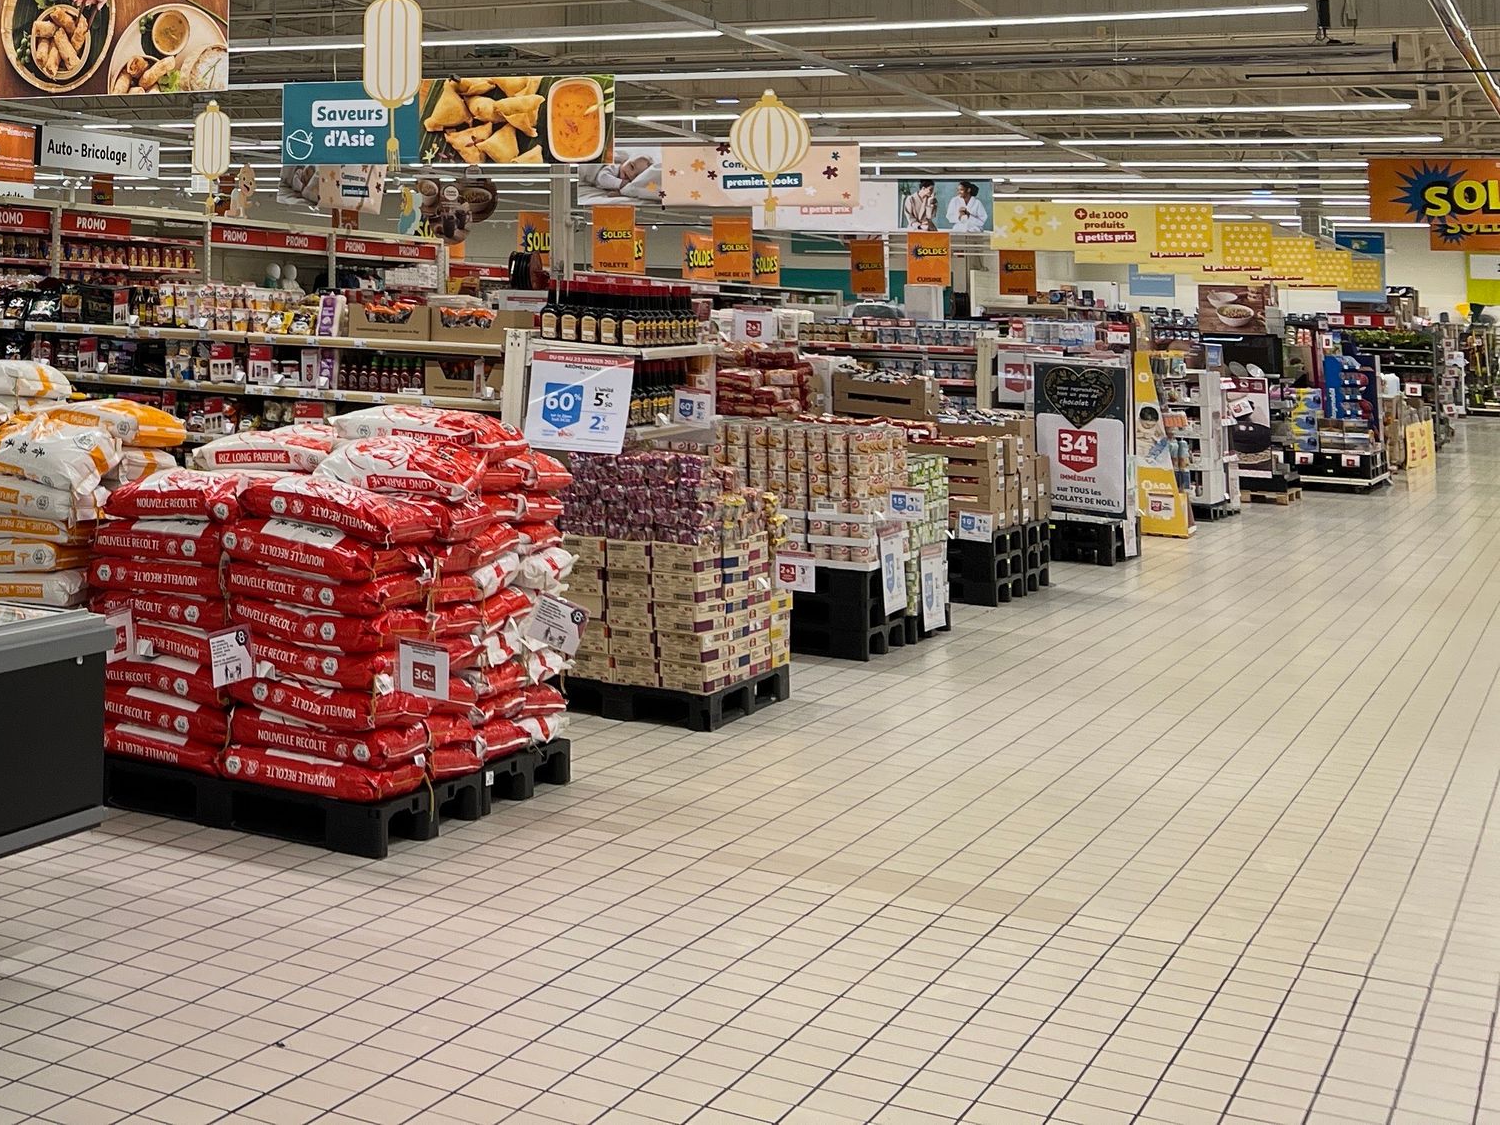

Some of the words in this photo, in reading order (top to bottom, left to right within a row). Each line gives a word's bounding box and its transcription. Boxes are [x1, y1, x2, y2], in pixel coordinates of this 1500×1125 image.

[316, 105, 384, 123] Saveurs
[323, 129, 375, 148] d'Asie
[47, 138, 73, 158] Auto
[80, 142, 128, 164] Bricolage
[1089, 210, 1101, 219] de
[1102, 210, 1129, 220] 1000
[76, 216, 107, 231] PROMO
[1083, 220, 1126, 230] produits
[222, 229, 248, 243] PROMO
[285, 235, 309, 248] PROMO
[601, 230, 633, 240] SOLDES
[1084, 232, 1114, 243] petits
[1114, 232, 1136, 243] prix
[344, 241, 366, 254] PROMO
[398, 245, 420, 257] PROMO
[721, 243, 750, 252] SOLDES
[917, 247, 948, 256] SOLDES
[1059, 398, 1090, 407] chocolat
[1059, 433, 1097, 455] 34%
[218, 452, 231, 463] RIZ
[232, 452, 253, 463] LONG
[1060, 472, 1096, 483] IMMÉDIATE
[1069, 486, 1090, 495] TOUS
[1090, 488, 1102, 496] les
[169, 497, 198, 509] RECOLTE
[1050, 493, 1084, 505] OCOLATS
[1084, 497, 1094, 505] DE
[1095, 497, 1116, 508] NOËL
[97, 535, 131, 547] NOUVELLE
[131, 538, 160, 551] RECOLTE
[230, 573, 266, 591] NOUVELLE
[266, 578, 297, 596] RECOLTE
[133, 597, 163, 615] RECOLTE
[235, 603, 269, 624] NOUVELLE
[105, 669, 125, 682] VELLE
[104, 700, 123, 715] VELLE
[257, 729, 296, 747] NOUVELLE
[295, 737, 328, 753] RECOLTE
